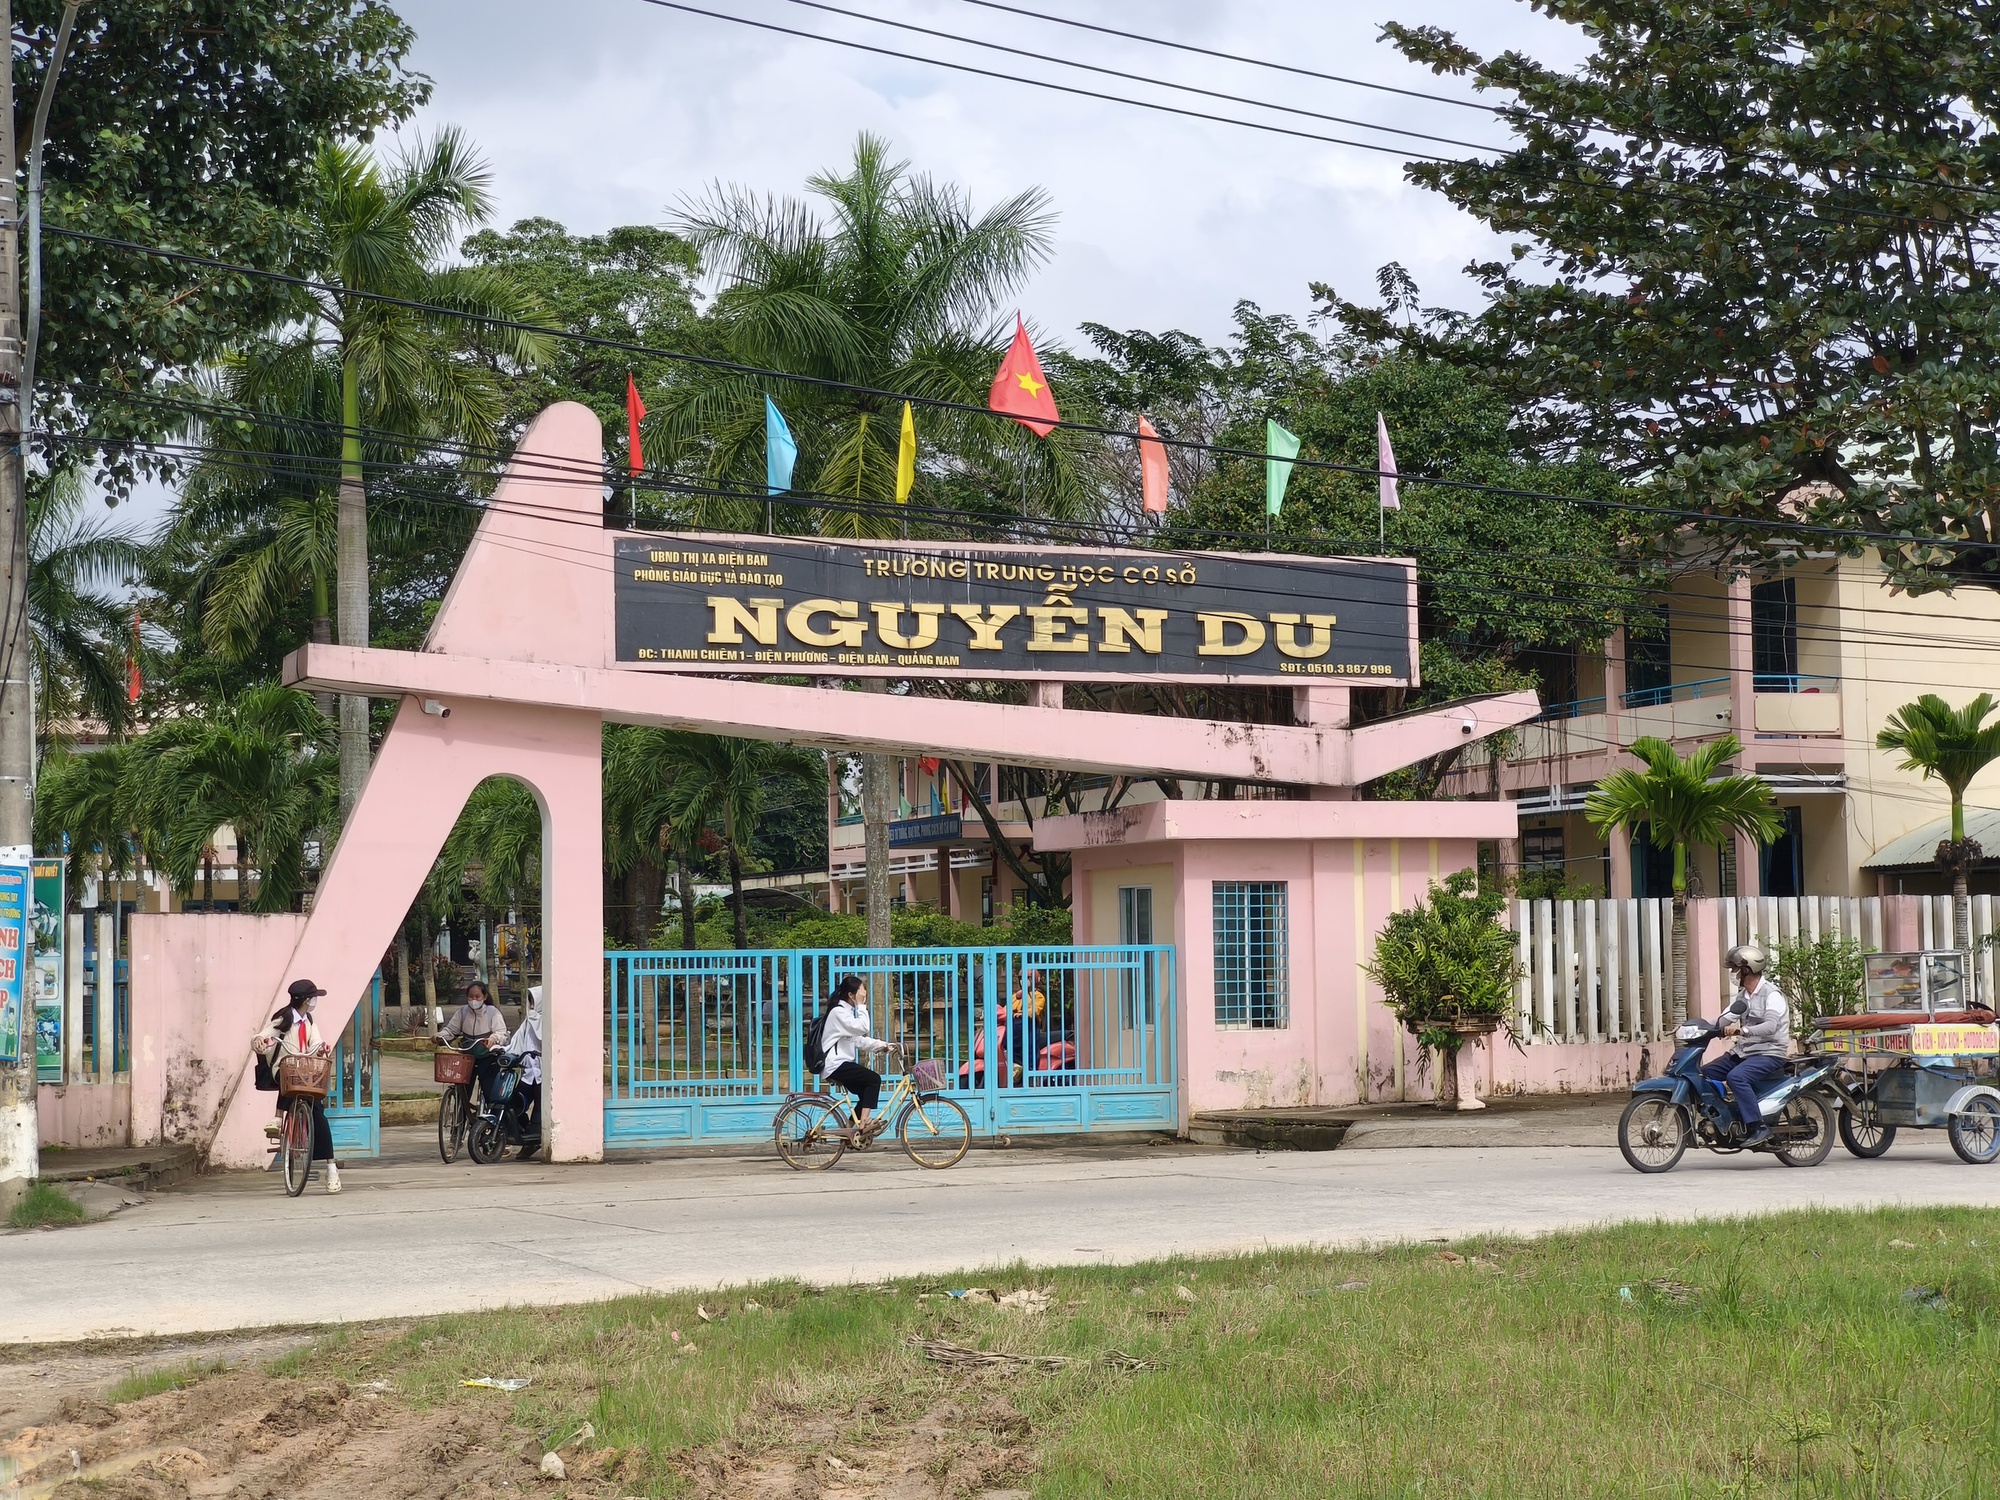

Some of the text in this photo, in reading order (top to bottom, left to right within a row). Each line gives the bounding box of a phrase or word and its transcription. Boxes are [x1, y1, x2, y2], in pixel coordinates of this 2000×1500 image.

[650, 550, 680, 564] UBND
[682, 552, 700, 567] THỊ
[634, 567, 784, 589] PHÒNG GIÁO DỤC VÀ ĐÀO TẠO
[973, 562, 1056, 583] TRUNG
[1062, 564, 1116, 587] HỌC
[1122, 564, 1160, 586] CƠ
[1165, 561, 1198, 586] SỞ
[706, 583, 1338, 659] NGUYỄN DU
[638, 648, 658, 660] ĐC:
[660, 649, 698, 661] THANH
[739, 650, 745, 661] 1
[754, 649, 782, 664] ĐIỆN
[784, 650, 828, 663] PHƯƠNG
[838, 651, 865, 666] ĐIỆN
[867, 651, 889, 665] BÀN
[898, 650, 934, 666] QUẢNG
[935, 655, 960, 667] NAM
[1280, 662, 1306, 673] SĐT:
[1370, 665, 1392, 675] 996
